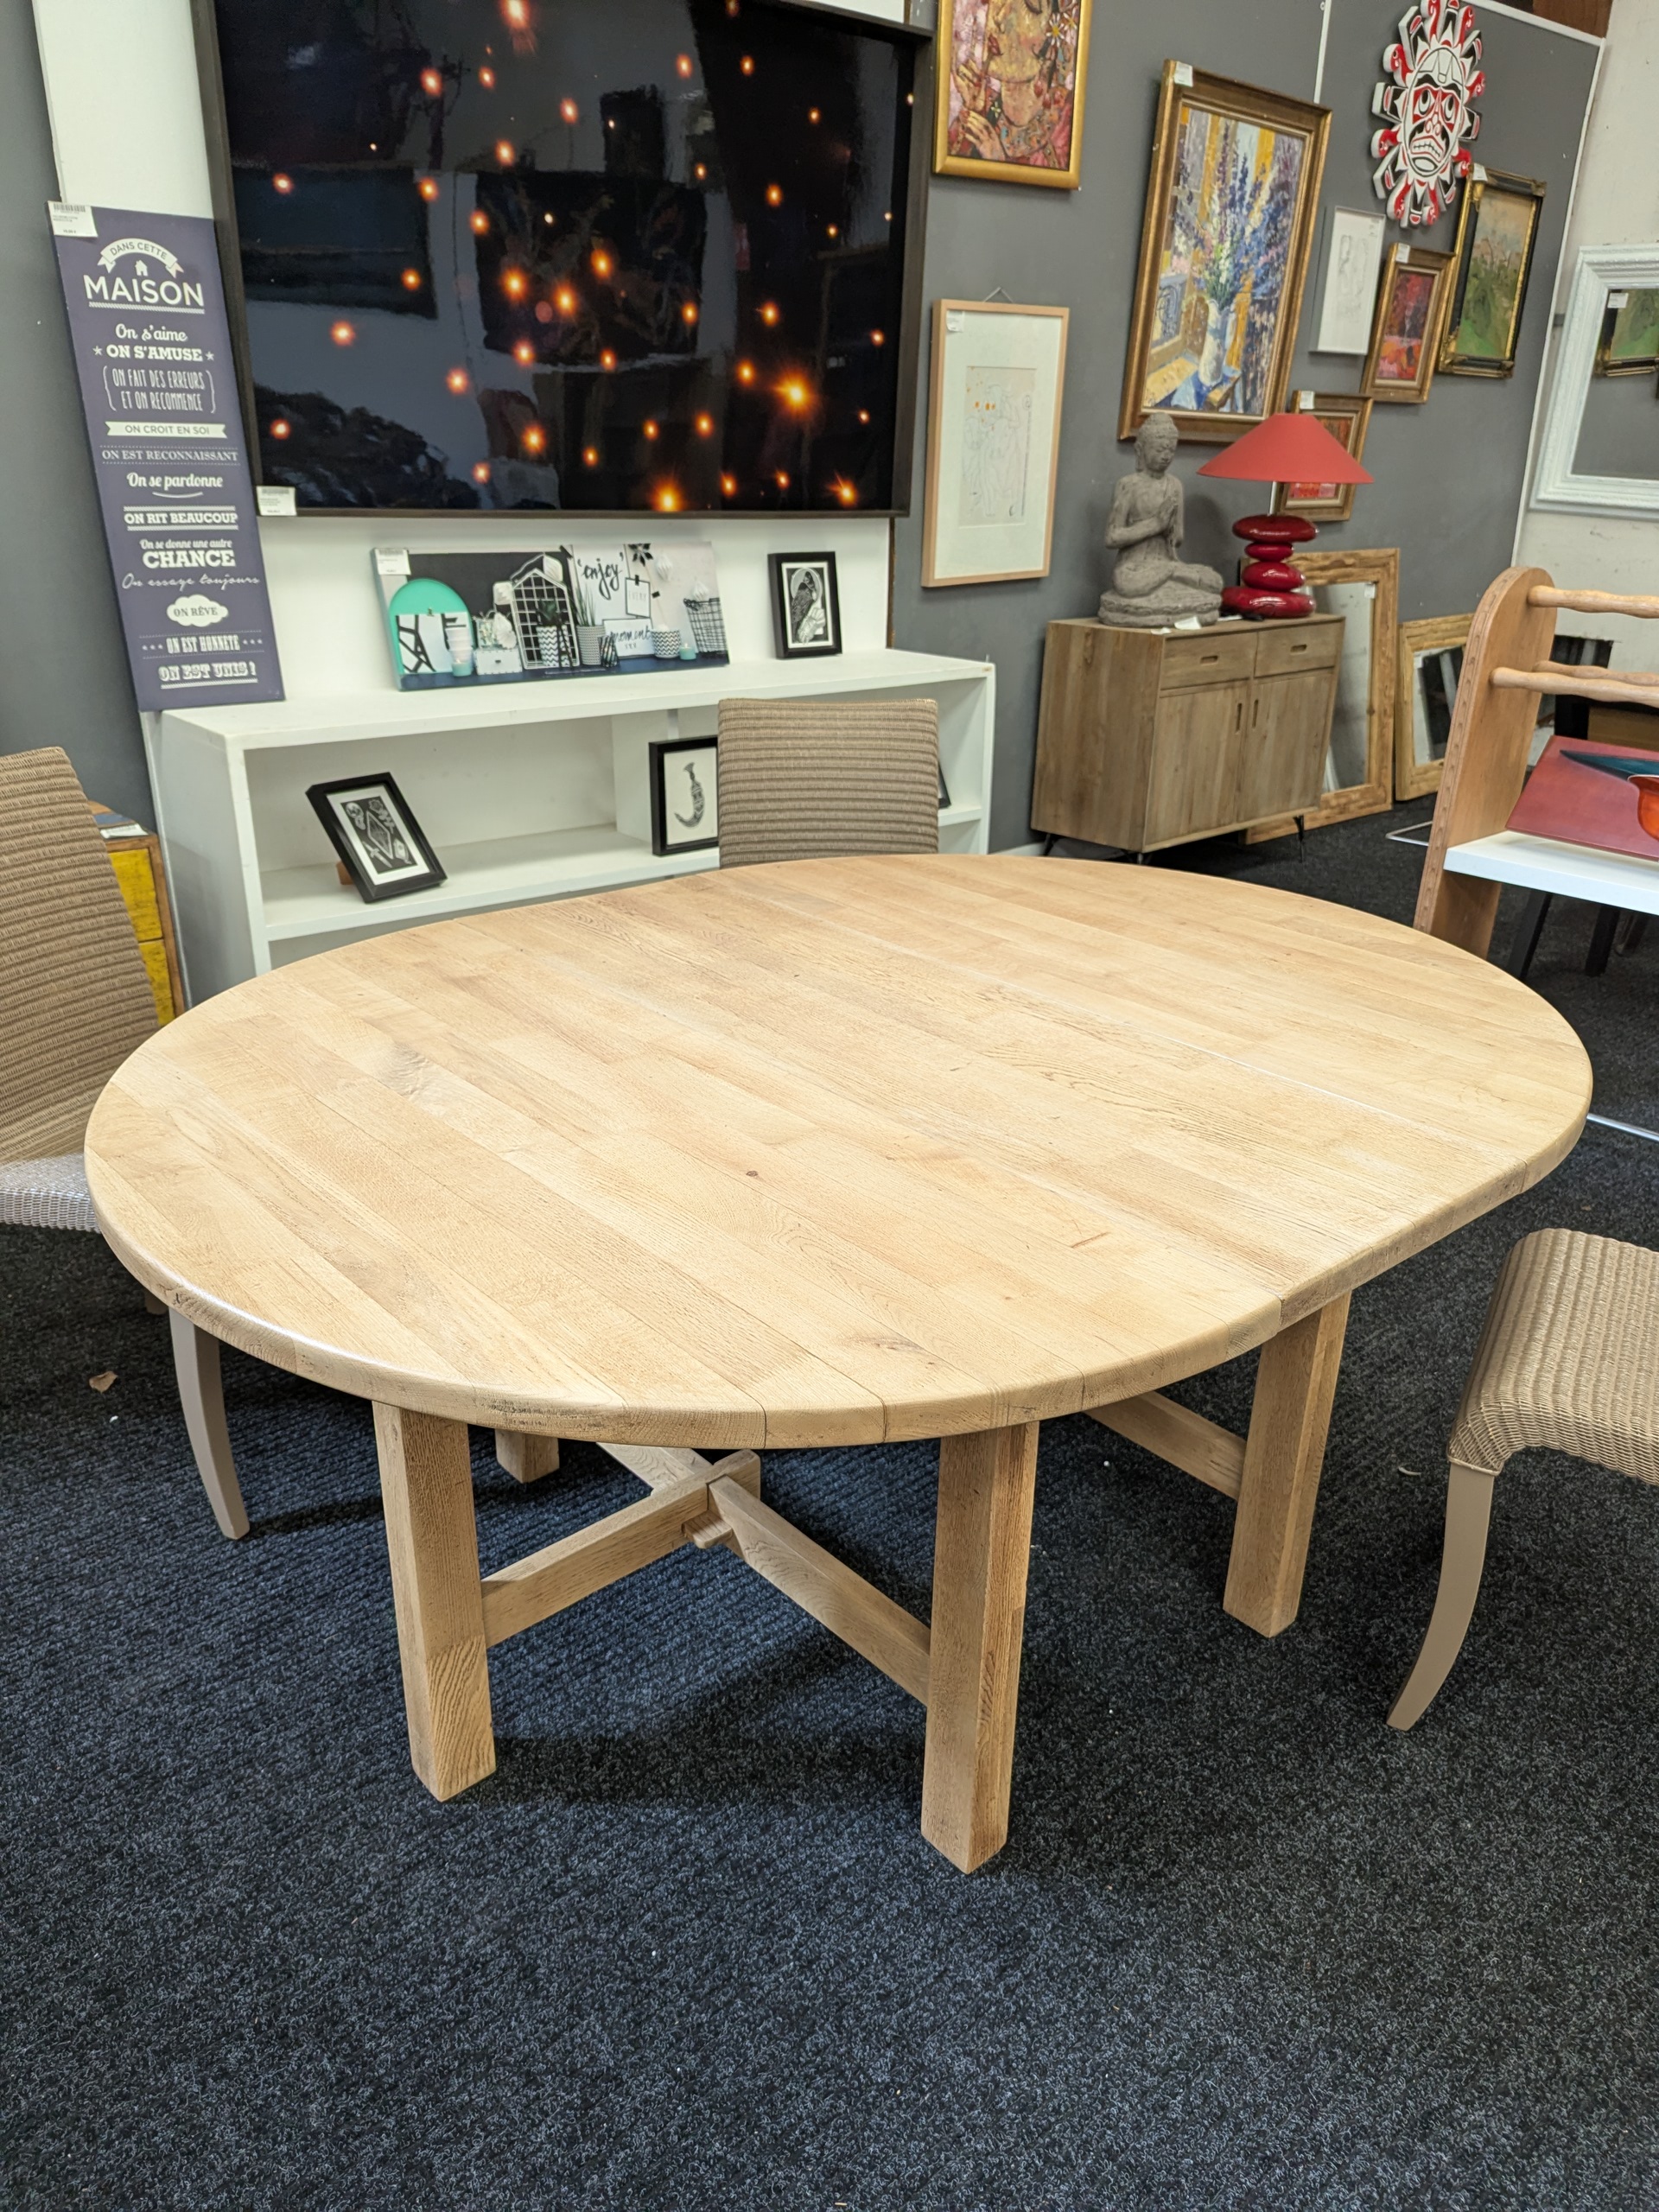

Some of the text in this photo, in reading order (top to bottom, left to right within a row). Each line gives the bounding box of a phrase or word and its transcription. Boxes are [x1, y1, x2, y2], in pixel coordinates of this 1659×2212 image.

[110, 241, 168, 261] DANS CETTE
[83, 274, 205, 307] MAISON
[115, 323, 188, 342] On s'aime
[106, 344, 204, 362] ON S'AMUSE
[111, 368, 206, 390] ON FAIT DES ERREURS
[120, 391, 204, 411] ET ON RECOMMENCE
[124, 424, 210, 435] ON CROIT EN SOI
[102, 449, 239, 461] ON EST RECONNAISSANT
[126, 472, 224, 492] On se pardonne
[124, 512, 238, 524] ON RIT BEAUCOUP
[139, 538, 233, 550] On se donne une autre
[142, 549, 237, 569] CHANCE
[122, 572, 261, 592] On essaye toujours
[173, 606, 219, 617] ON RÊVE
[166, 637, 181, 654] ON
[180, 636, 199, 653] EST
[158, 664, 181, 682] ON
[181, 663, 211, 680] EST
[211, 661, 249, 678] UNIS
